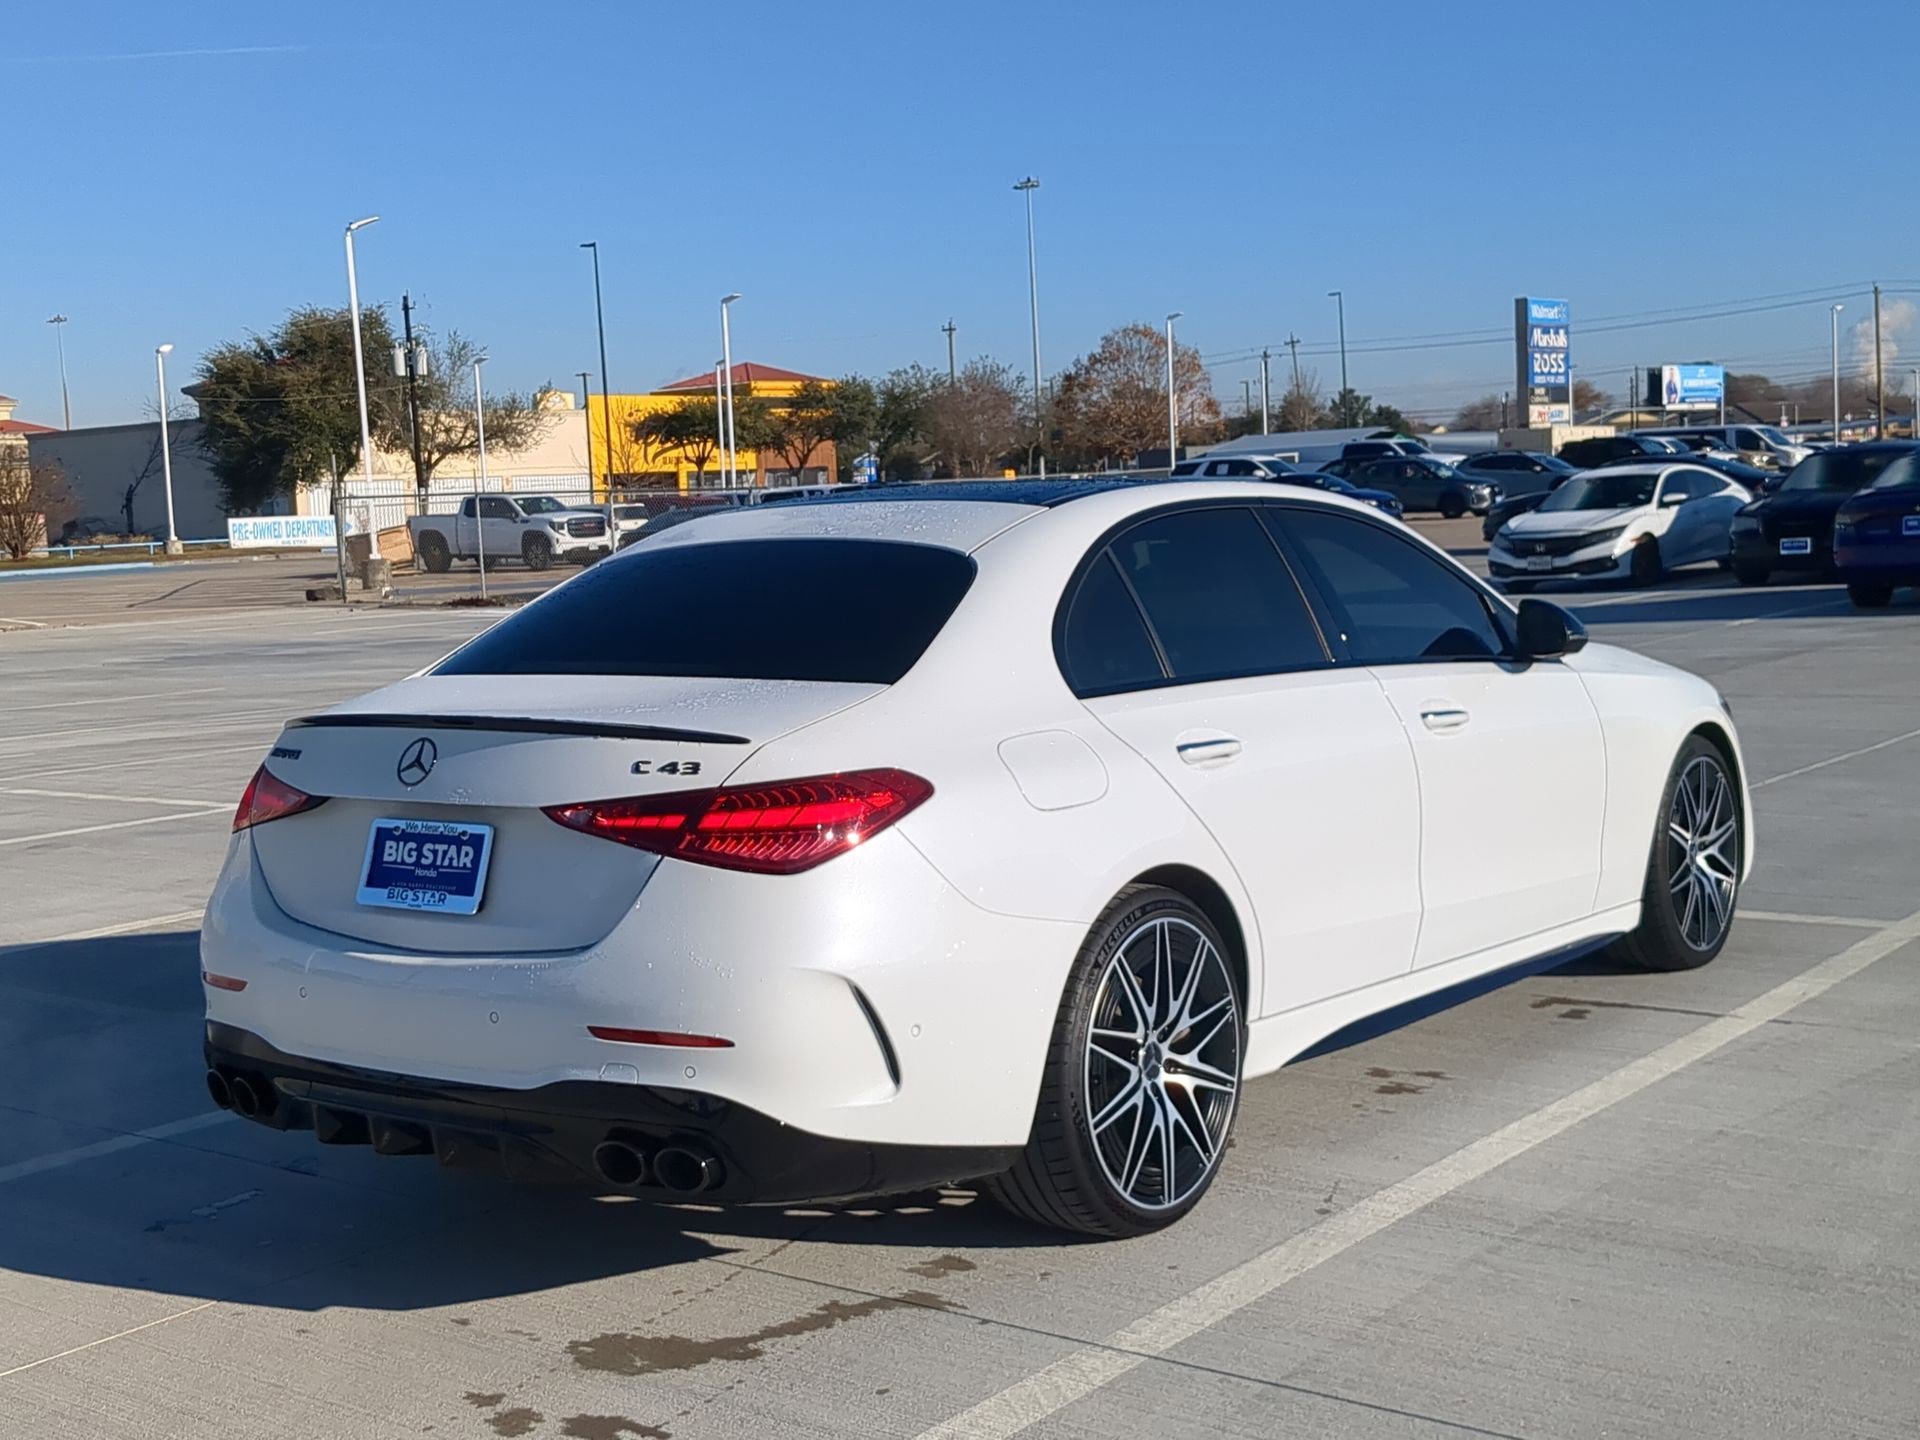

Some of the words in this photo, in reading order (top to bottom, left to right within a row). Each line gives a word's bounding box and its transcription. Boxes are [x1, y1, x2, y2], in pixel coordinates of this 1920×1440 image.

[1533, 353, 1566, 374] ROSS
[232, 521, 283, 541] PRE-OWNED
[285, 519, 337, 538] DEPARTMEN
[630, 760, 652, 775] C
[656, 761, 701, 775] 43
[405, 821, 419, 832] We
[421, 823, 440, 833] Hear
[441, 824, 459, 834] You
[382, 840, 417, 864] BIG
[420, 843, 474, 868] STAR
[415, 868, 437, 877] Honda
[387, 887, 409, 901] BIG
[412, 890, 447, 904] STAR
[1097, 907, 1143, 966] MICHELIN
